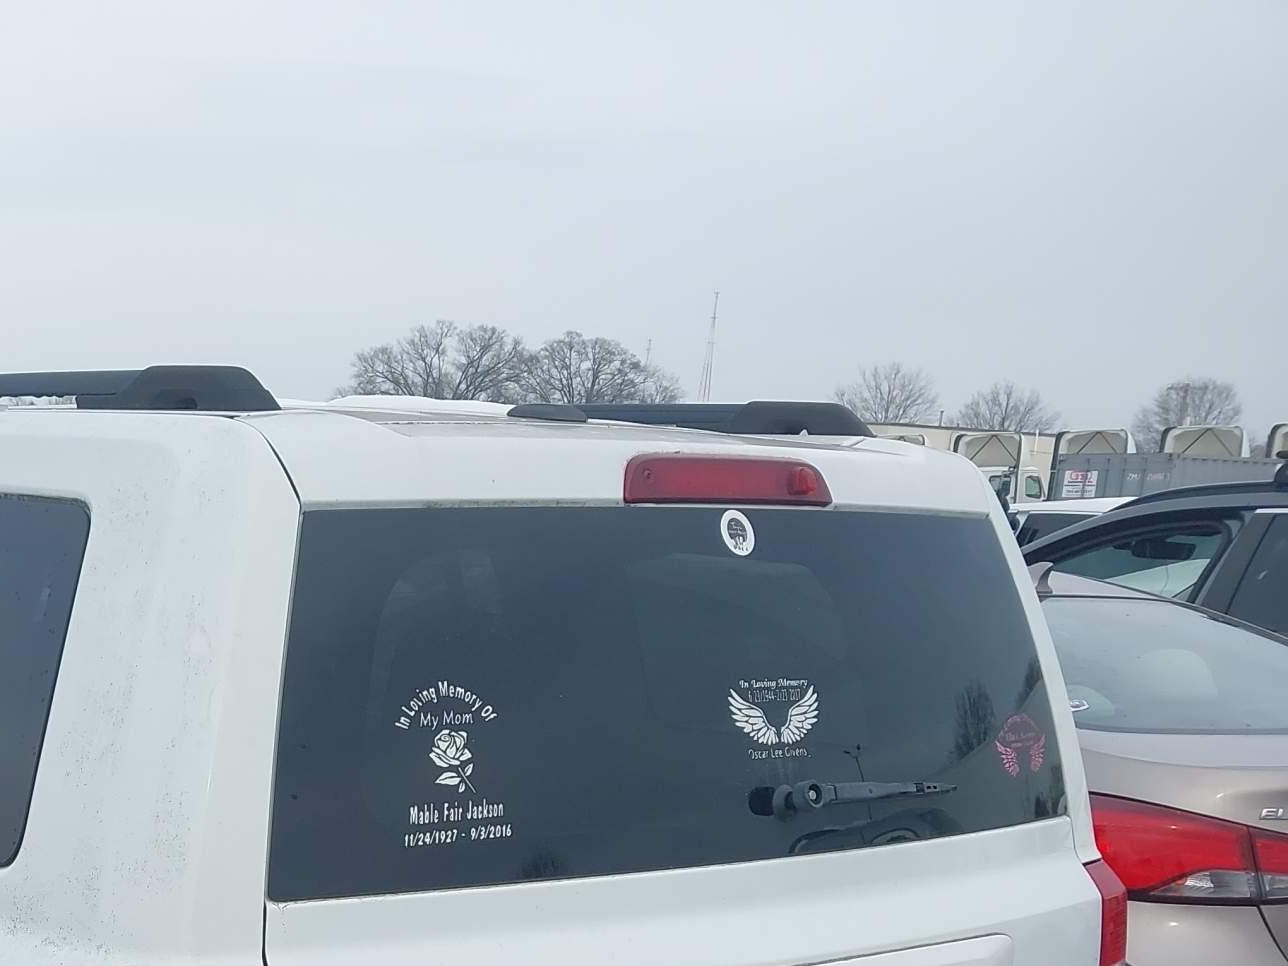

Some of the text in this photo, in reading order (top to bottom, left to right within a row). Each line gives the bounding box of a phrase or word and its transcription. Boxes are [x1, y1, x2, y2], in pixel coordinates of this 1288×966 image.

[394, 680, 499, 730] In Loving Memory Of
[419, 710, 474, 730] My Mom
[409, 798, 504, 825] Mable Fair Jackson
[404, 829, 458, 848] 11/24/1927
[470, 823, 513, 841] 9/3/2016
